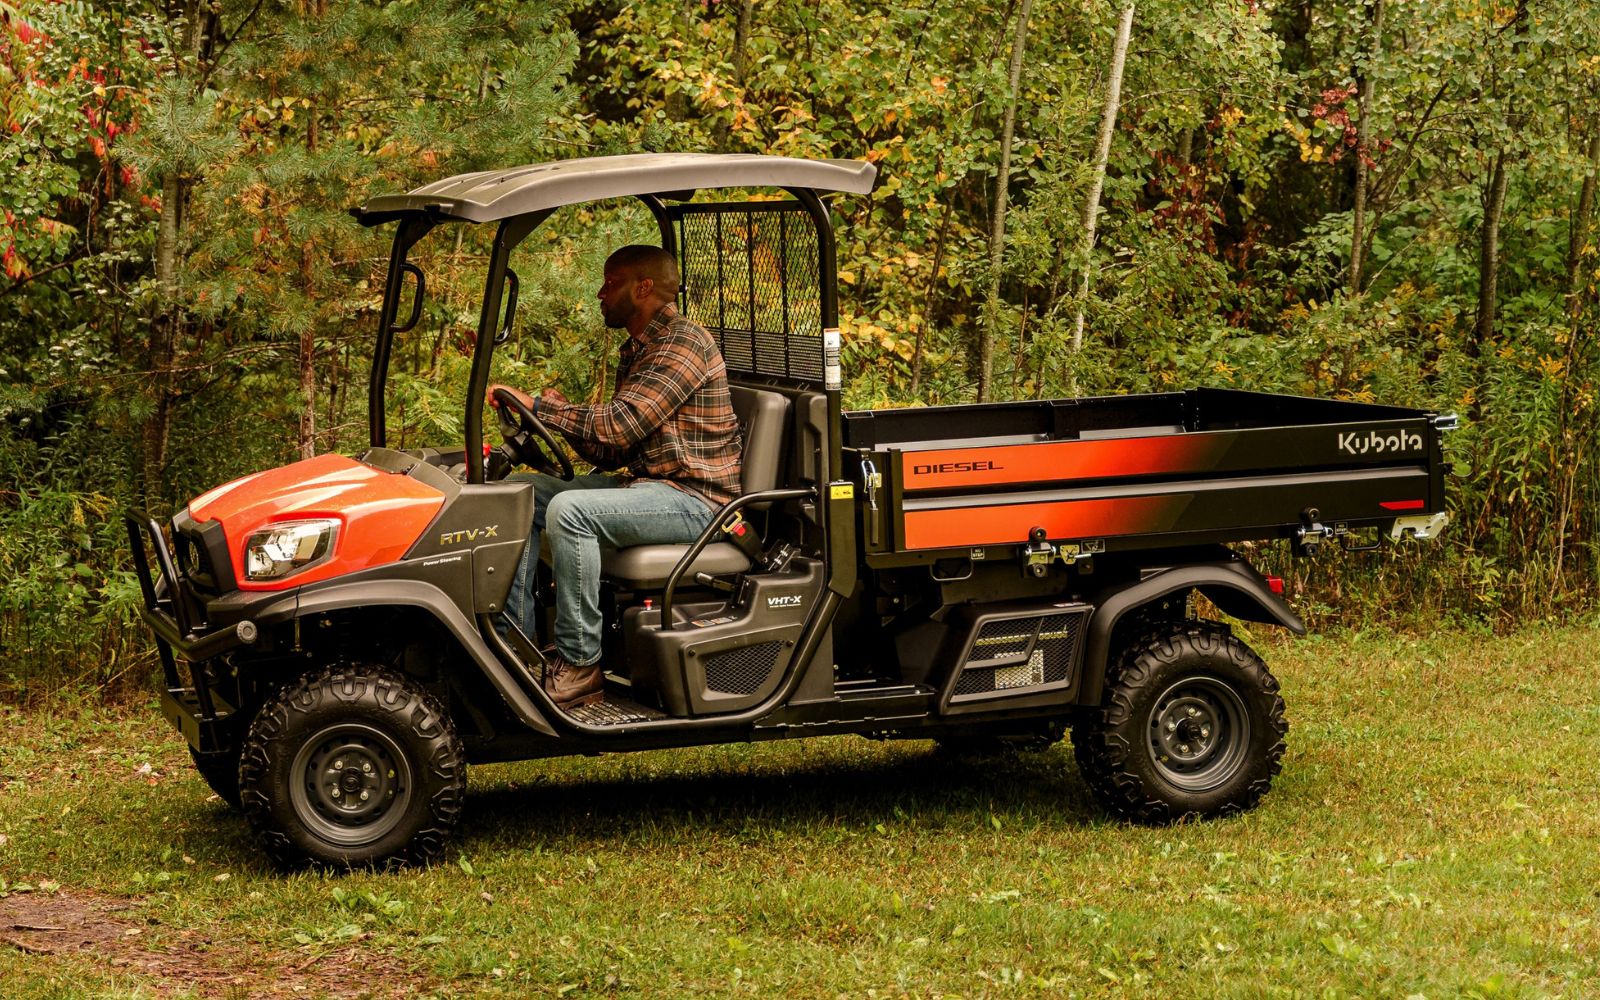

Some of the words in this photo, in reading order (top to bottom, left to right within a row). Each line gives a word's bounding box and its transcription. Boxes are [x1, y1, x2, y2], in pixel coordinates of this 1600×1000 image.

[1338, 429, 1423, 455] Kubota
[914, 461, 1004, 475] DIESEL
[440, 525, 499, 546] RTV-X
[423, 559, 440, 567] Power
[439, 556, 462, 564] Steering
[767, 595, 802, 605] VHT-X
